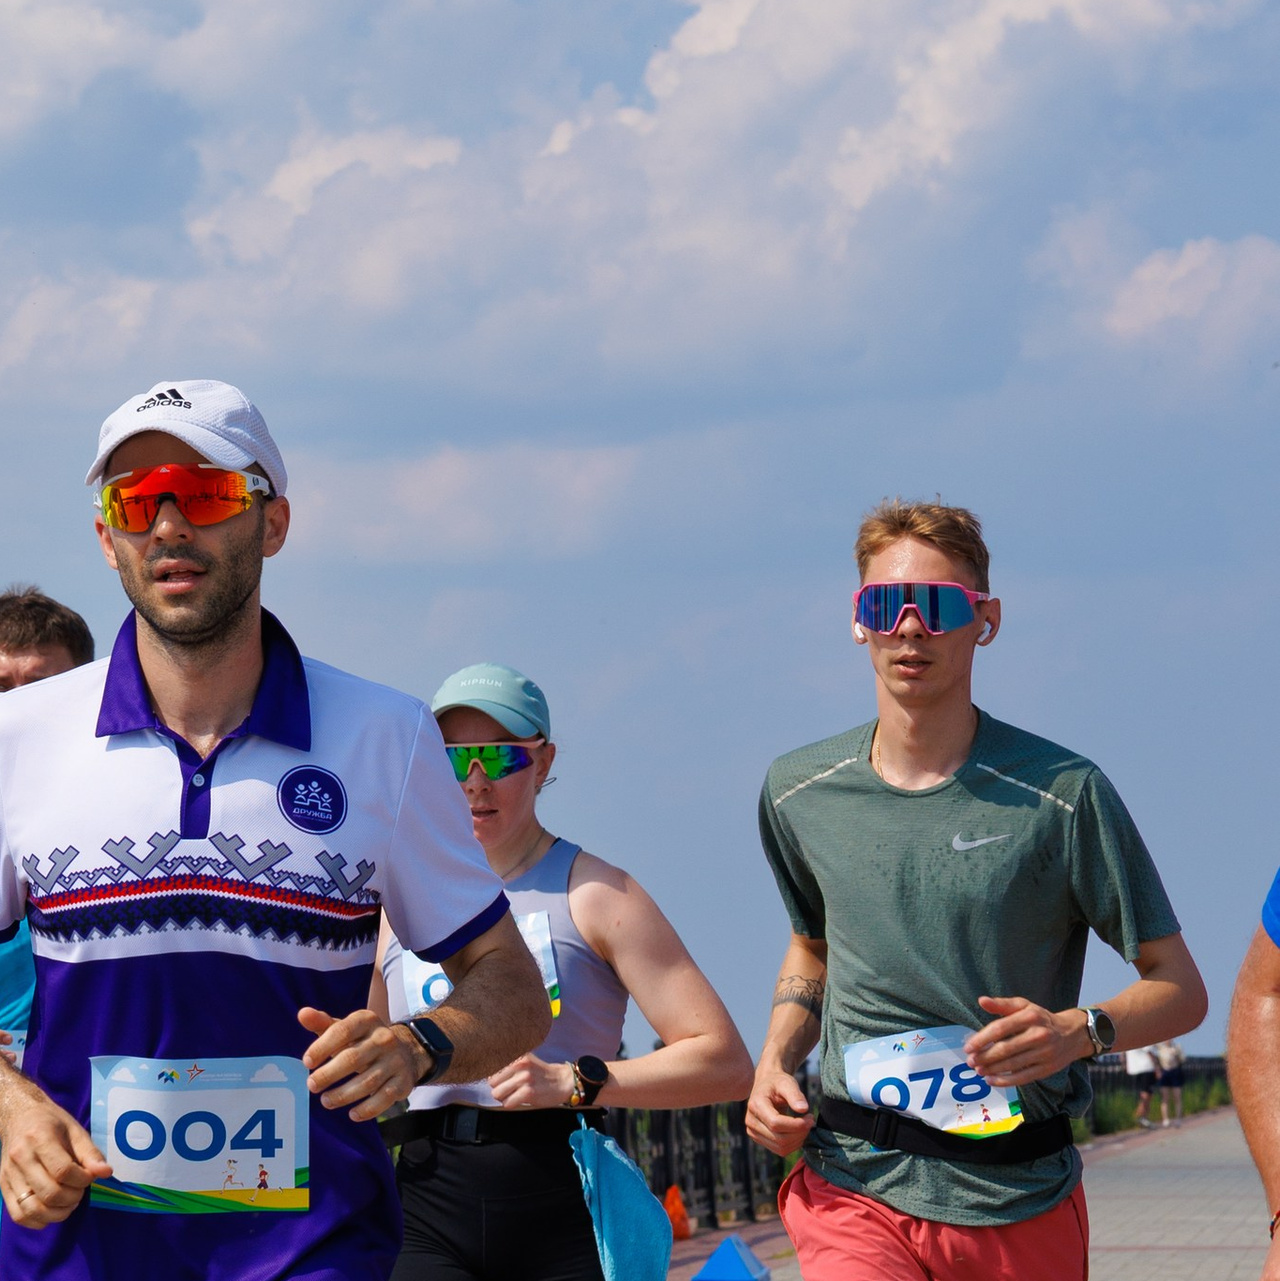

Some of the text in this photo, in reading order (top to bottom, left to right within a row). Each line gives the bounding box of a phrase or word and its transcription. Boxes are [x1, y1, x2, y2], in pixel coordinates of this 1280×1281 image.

[136, 398, 192, 412] adidas
[460, 678, 503, 687] KIPRUN
[292, 807, 332, 820] ДРУЖБА
[871, 1062, 992, 1112] 078
[114, 1109, 283, 1162] 004
